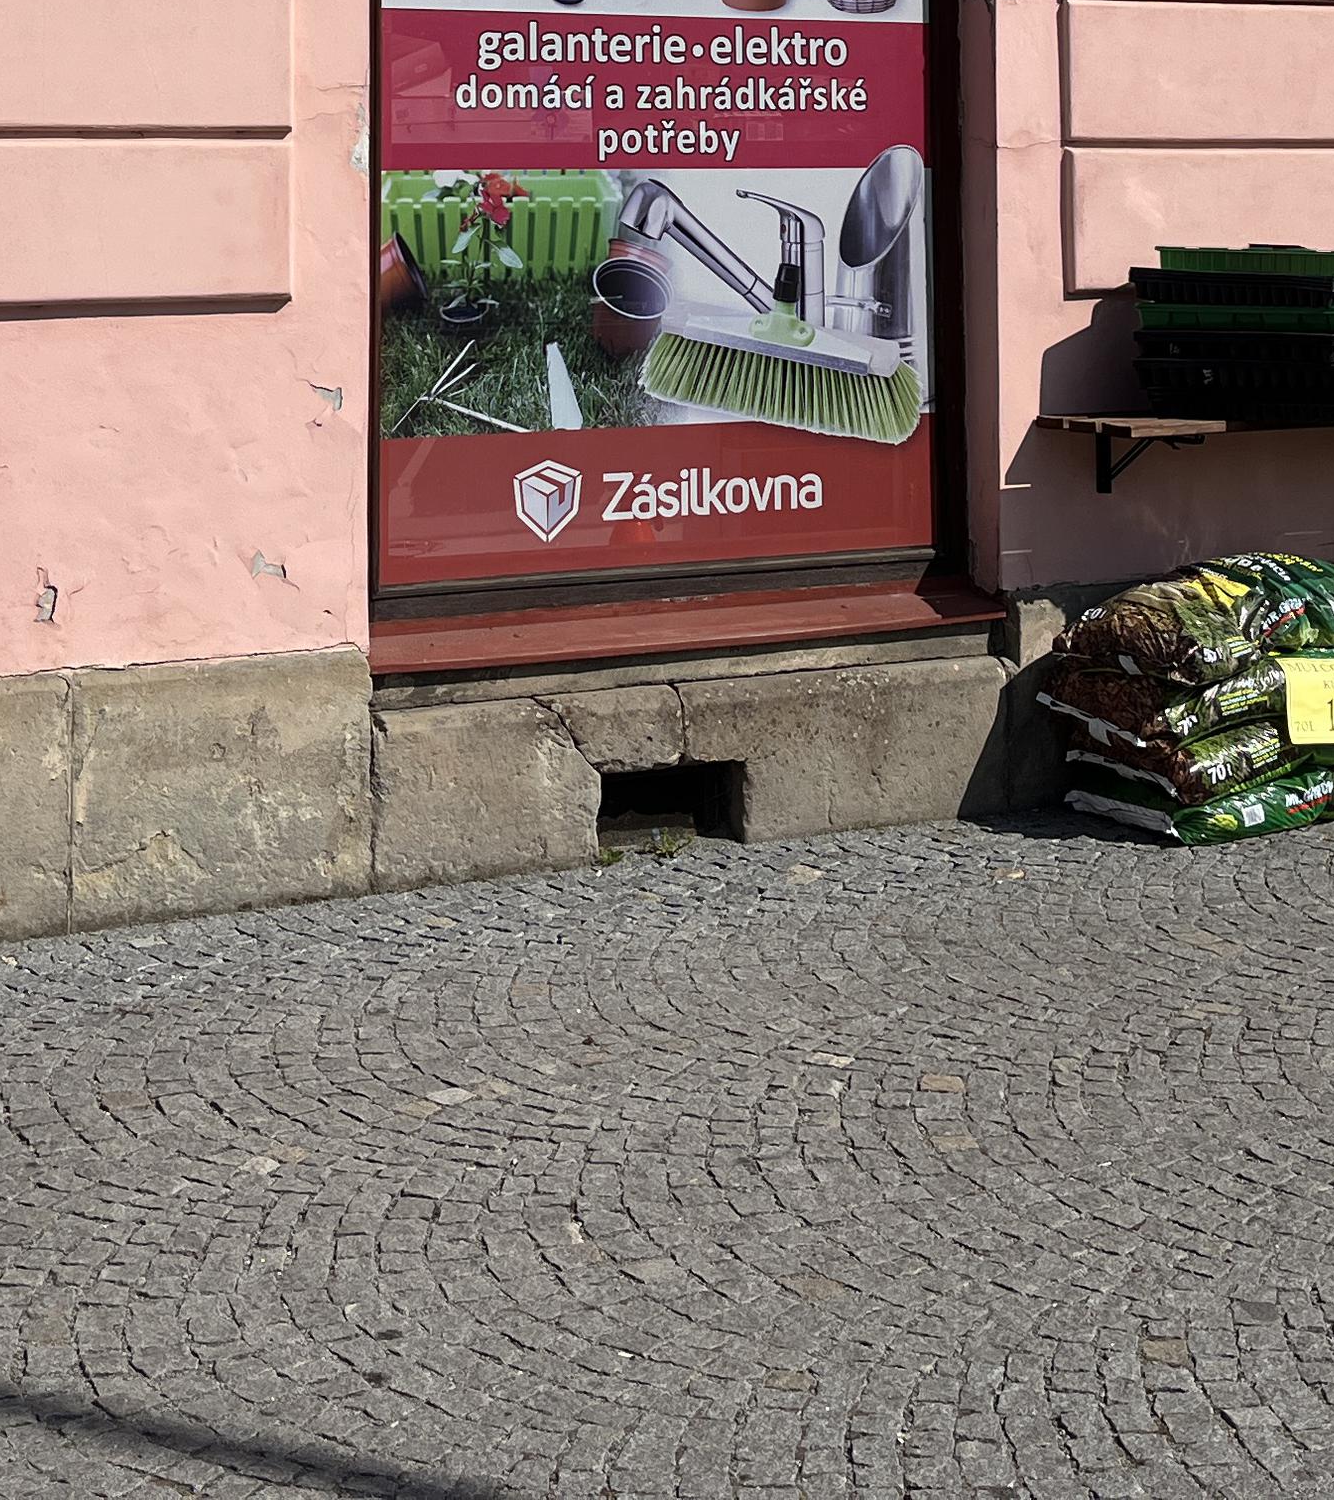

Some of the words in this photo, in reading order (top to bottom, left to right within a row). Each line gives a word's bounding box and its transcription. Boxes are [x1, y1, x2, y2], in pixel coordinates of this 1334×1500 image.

[477, 21, 687, 70] galanterie
[709, 26, 848, 66] elektro
[455, 74, 596, 110] domácí
[605, 84, 625, 110] a
[635, 76, 868, 113] zahrádkářské
[597, 120, 740, 161] potřeby
[602, 468, 823, 521] Zásilkovna
